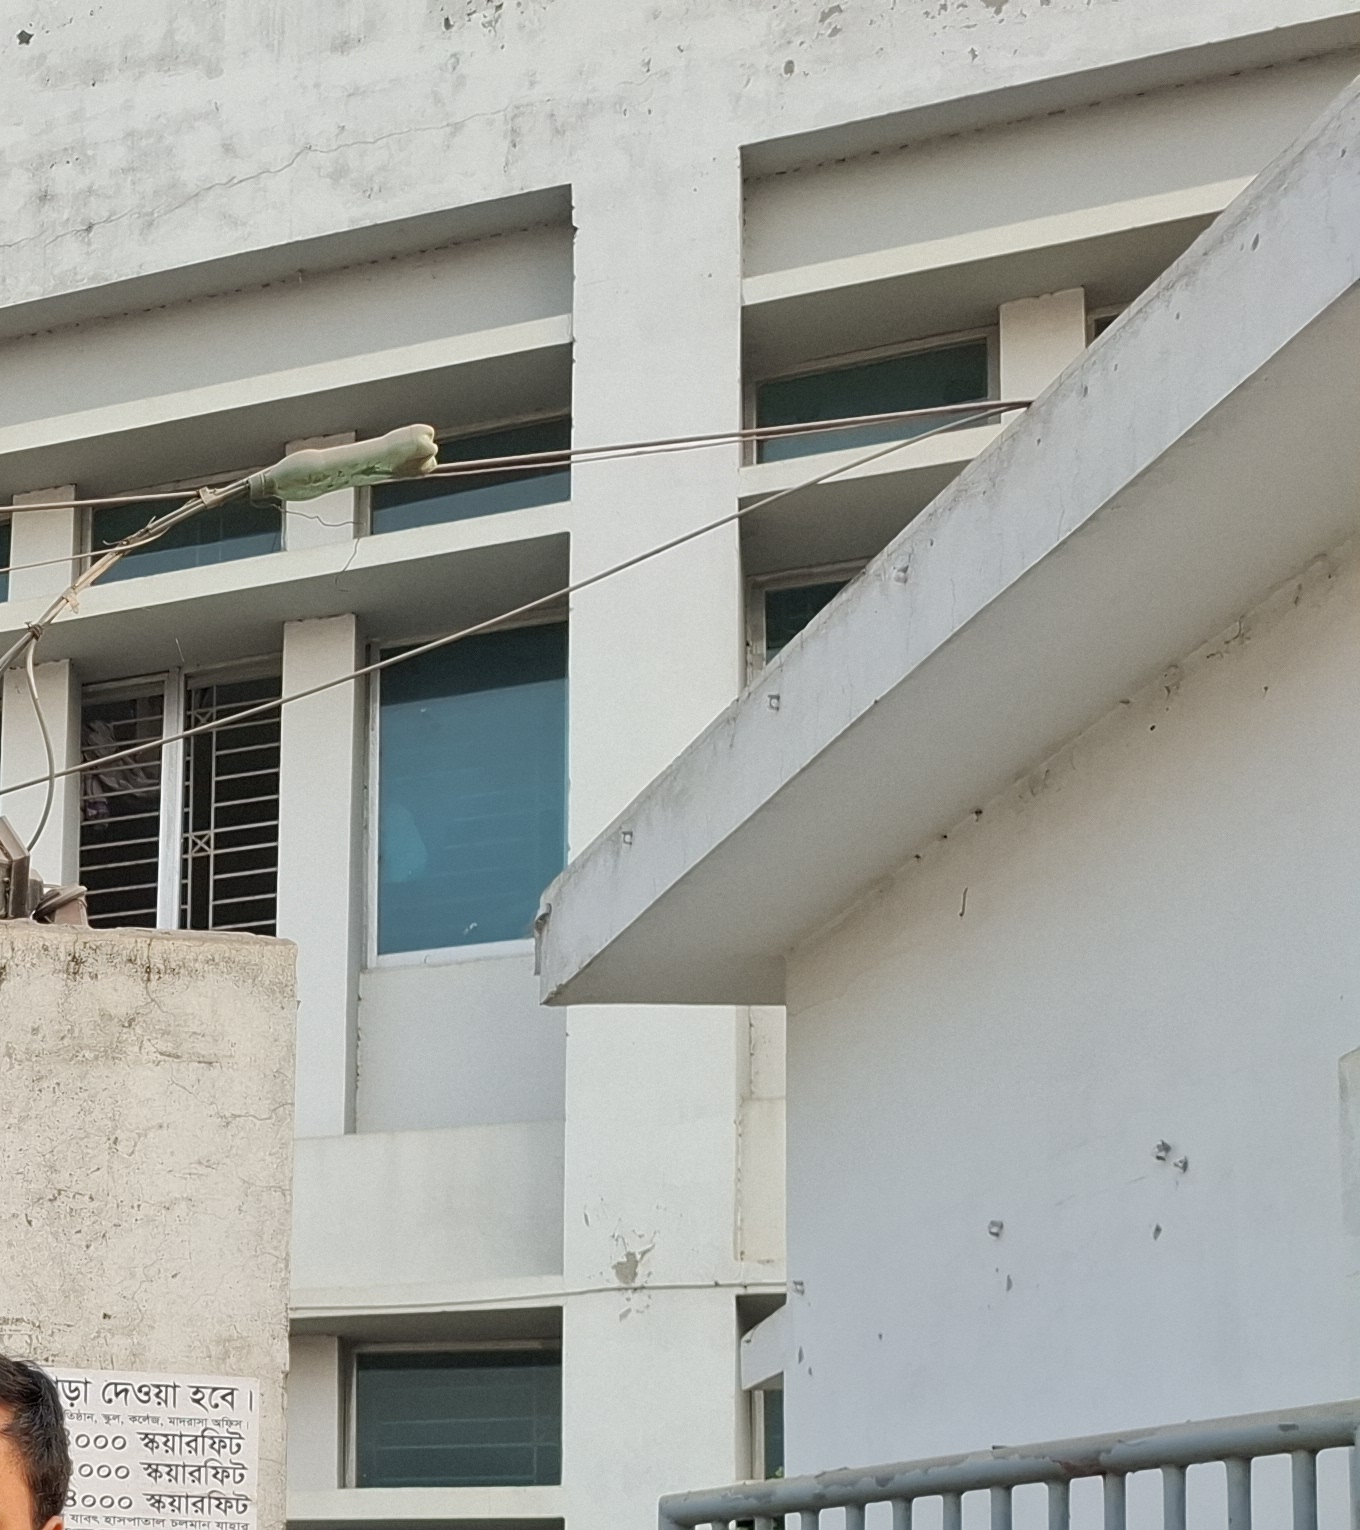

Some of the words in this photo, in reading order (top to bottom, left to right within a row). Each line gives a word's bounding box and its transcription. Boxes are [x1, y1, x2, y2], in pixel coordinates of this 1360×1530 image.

[102, 1380, 181, 1409] দেওয়া
[67, 1430, 127, 1451] ০০০
[136, 1427, 245, 1457] স্কয়ারফিট
[139, 1458, 249, 1486] স্কয়ারফিট
[142, 1490, 252, 1517] স্কয়ারফিট
[102, 1515, 166, 1528] হাসপাতাল
